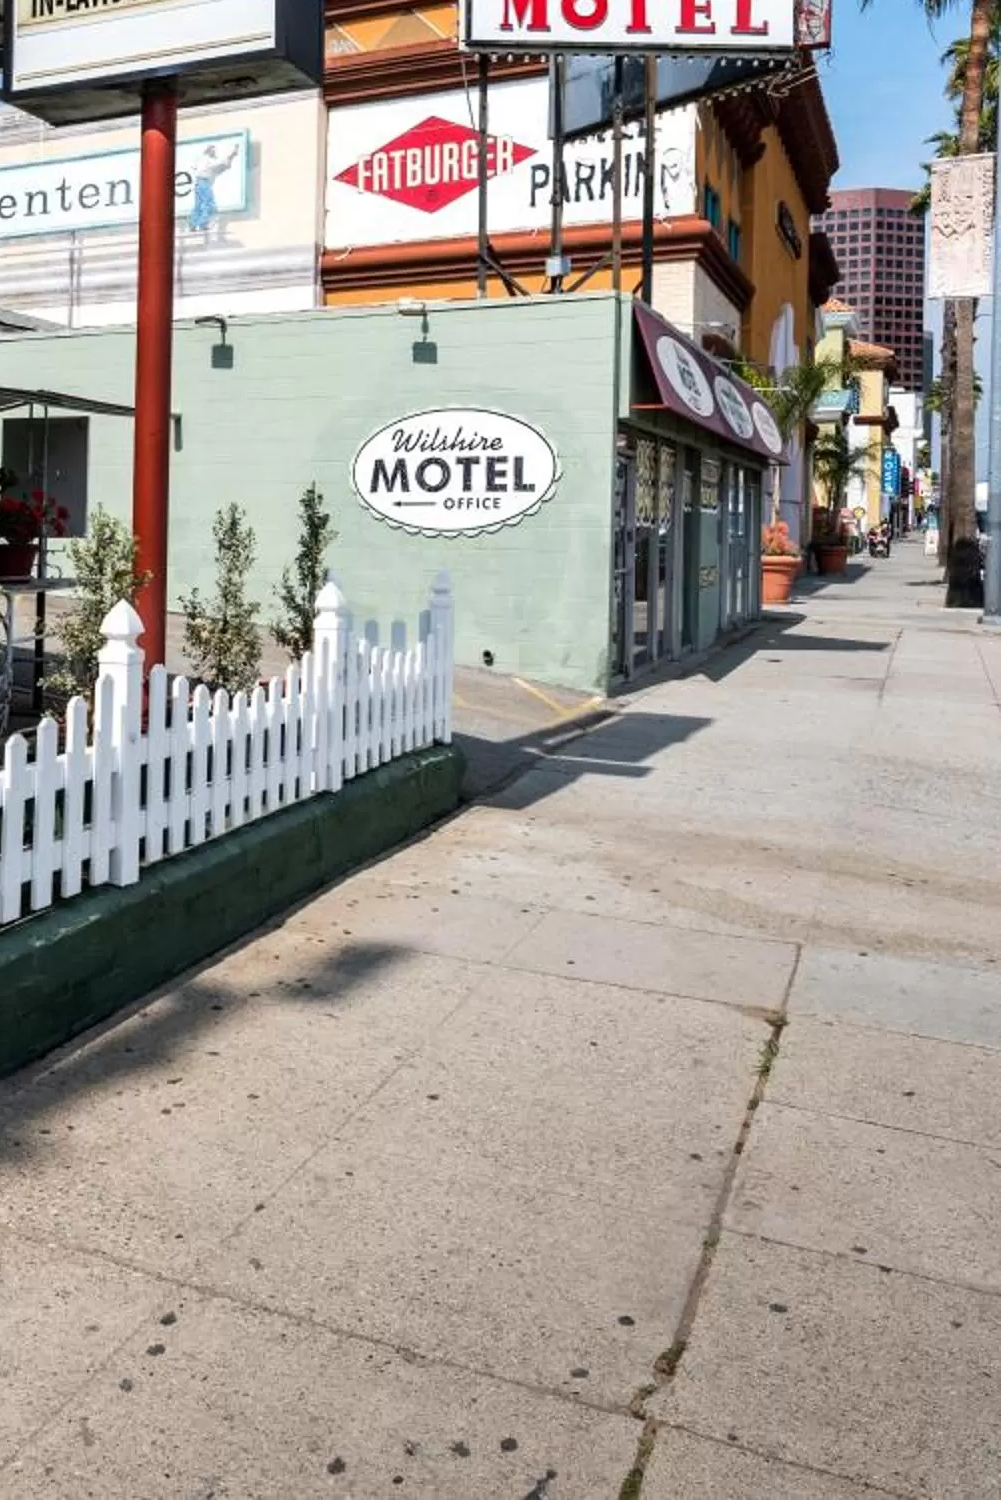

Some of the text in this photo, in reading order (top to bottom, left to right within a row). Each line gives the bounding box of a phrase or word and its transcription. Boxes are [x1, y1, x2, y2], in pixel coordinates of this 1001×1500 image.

[356, 134, 514, 195] FATBURGER
[391, 426, 504, 453] Wilshire
[369, 456, 536, 493] MOTEL
[443, 497, 501, 510] OFFICE
